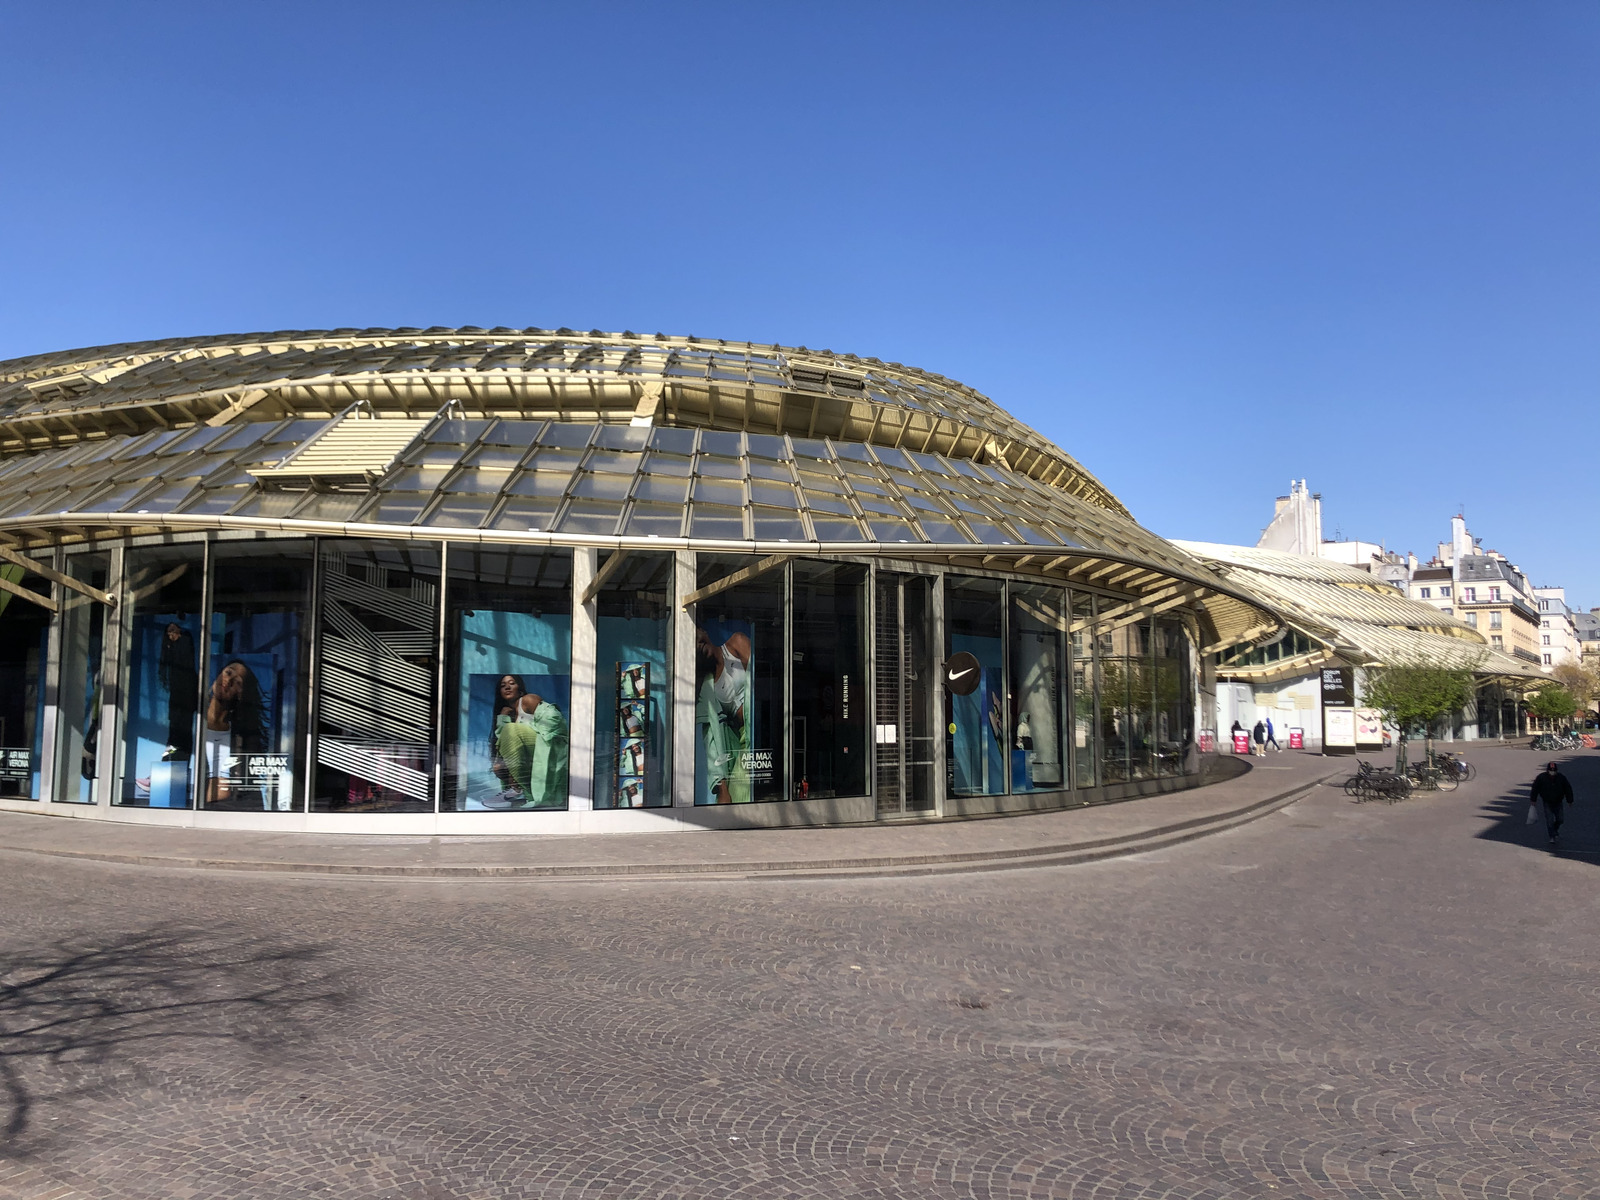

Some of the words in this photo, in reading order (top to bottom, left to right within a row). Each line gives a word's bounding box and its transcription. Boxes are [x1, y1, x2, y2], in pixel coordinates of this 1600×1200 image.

[9, 751, 17, 759] AIR
[18, 751, 29, 759] MAX
[742, 752, 754, 760] AIR
[756, 752, 772, 760] MAX
[249, 757, 264, 766] AIR
[266, 757, 288, 766] MAX
[742, 761, 772, 769] VERONA
[249, 766, 286, 775] VERONA
